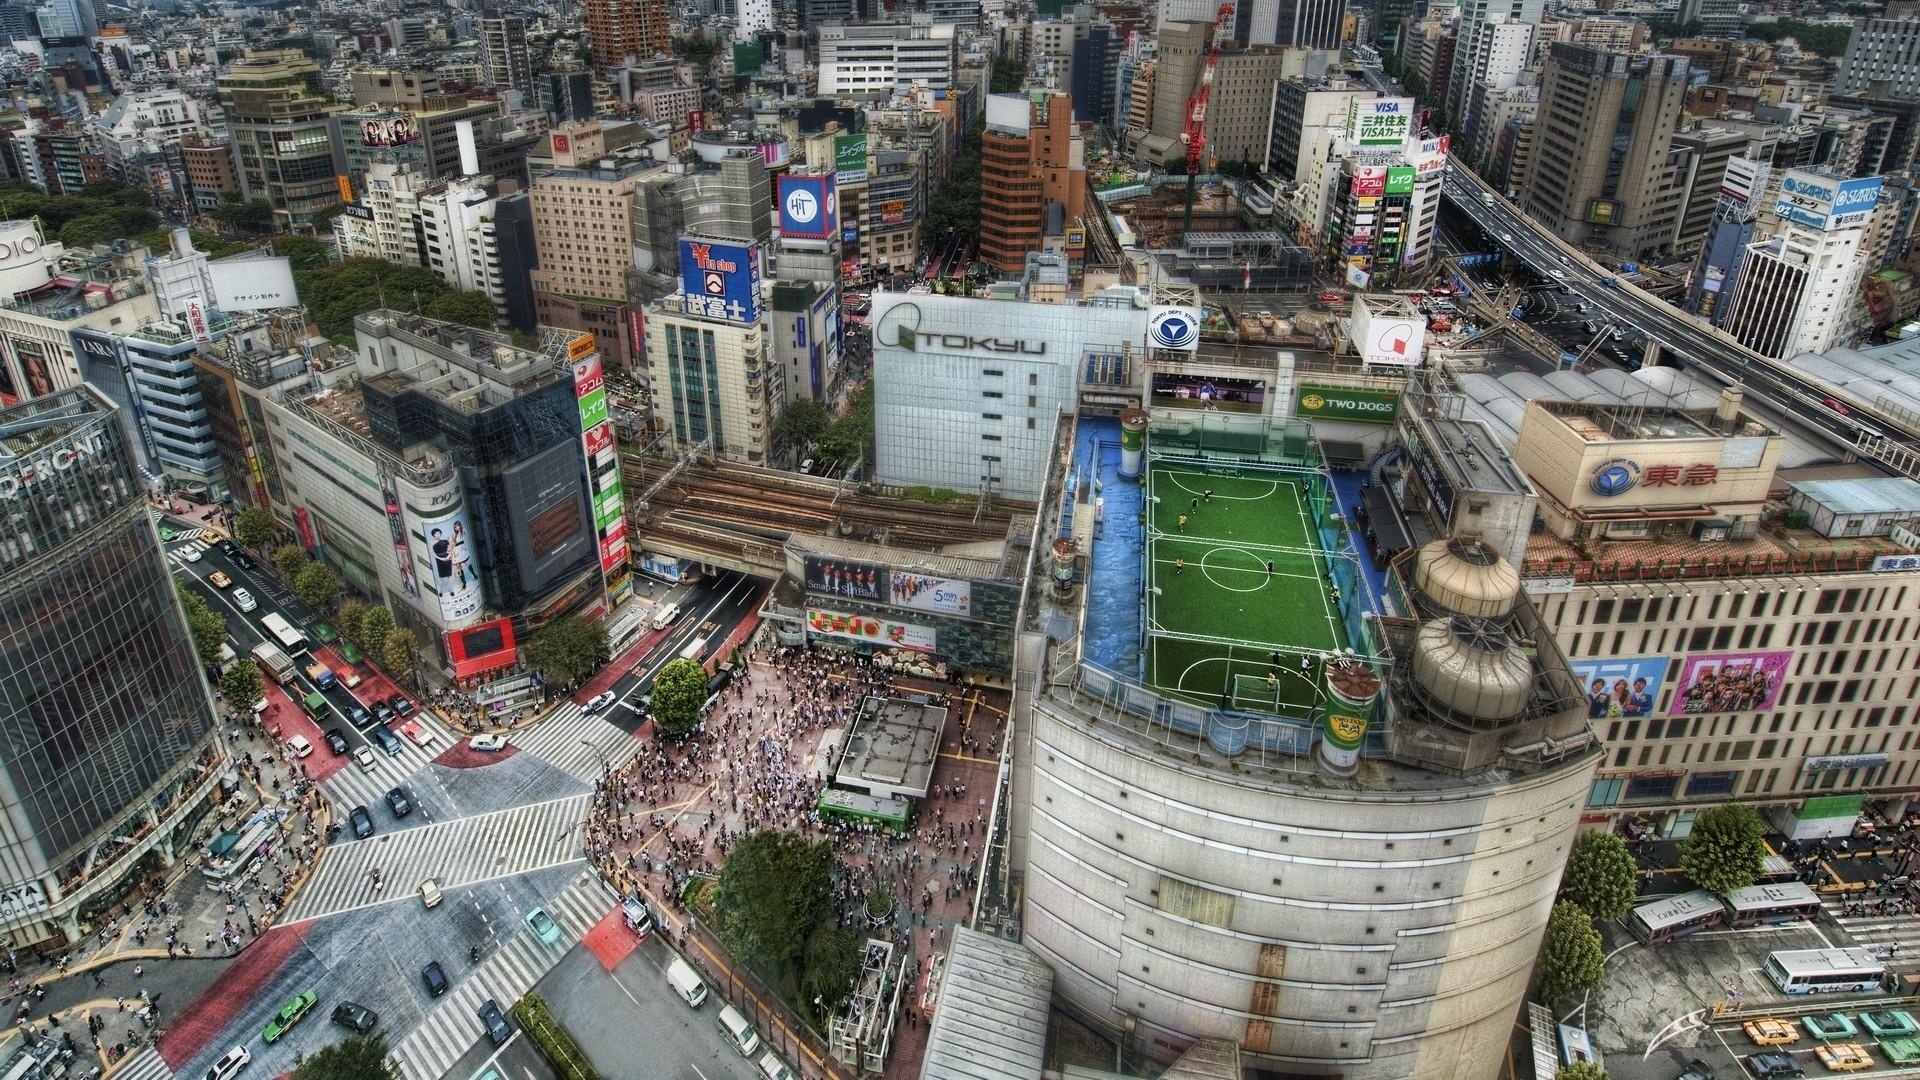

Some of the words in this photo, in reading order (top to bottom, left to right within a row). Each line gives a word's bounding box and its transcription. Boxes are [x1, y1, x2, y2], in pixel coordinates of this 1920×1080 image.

[1375, 102, 1399, 112] VISA
[1362, 115, 1408, 127] 三井住友
[686, 293, 747, 321] 武富士
[915, 332, 1046, 355] TOKYU
[1325, 399, 1356, 409] TWO
[1357, 402, 1394, 412] DOGS
[1641, 463, 1719, 488] 東急
